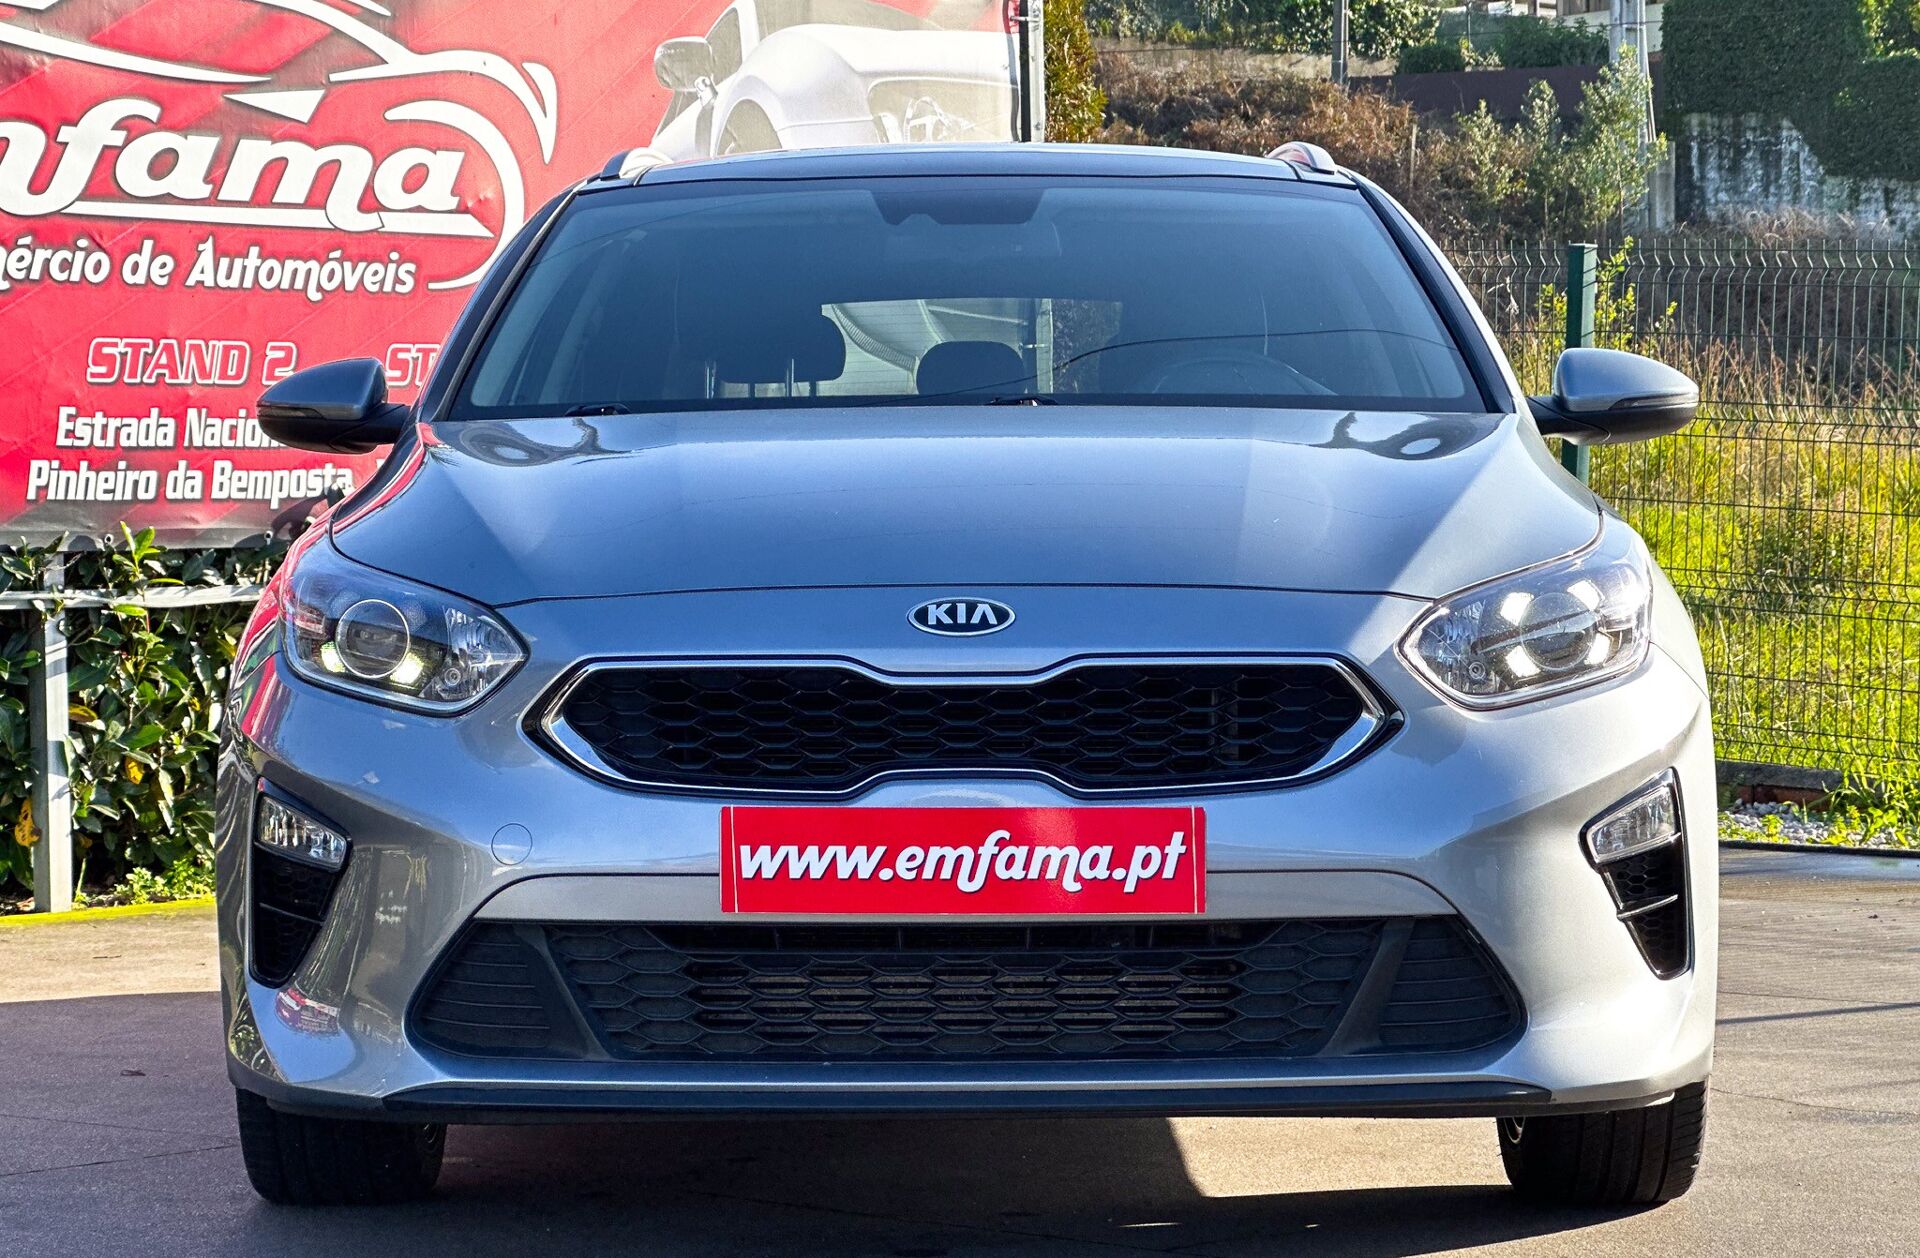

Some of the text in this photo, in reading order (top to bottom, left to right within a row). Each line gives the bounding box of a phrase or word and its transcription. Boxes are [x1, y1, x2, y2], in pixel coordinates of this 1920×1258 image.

[0, 98, 465, 232] fama
[0, 236, 111, 291] ércio
[121, 239, 175, 287] de
[87, 337, 297, 385] STAND 2
[56, 406, 287, 447] Estrada Nacio
[27, 459, 353, 509] Pinheiro da Bemposta
[927, 603, 998, 625] KIA
[740, 830, 1187, 893] www.emfama.pt
